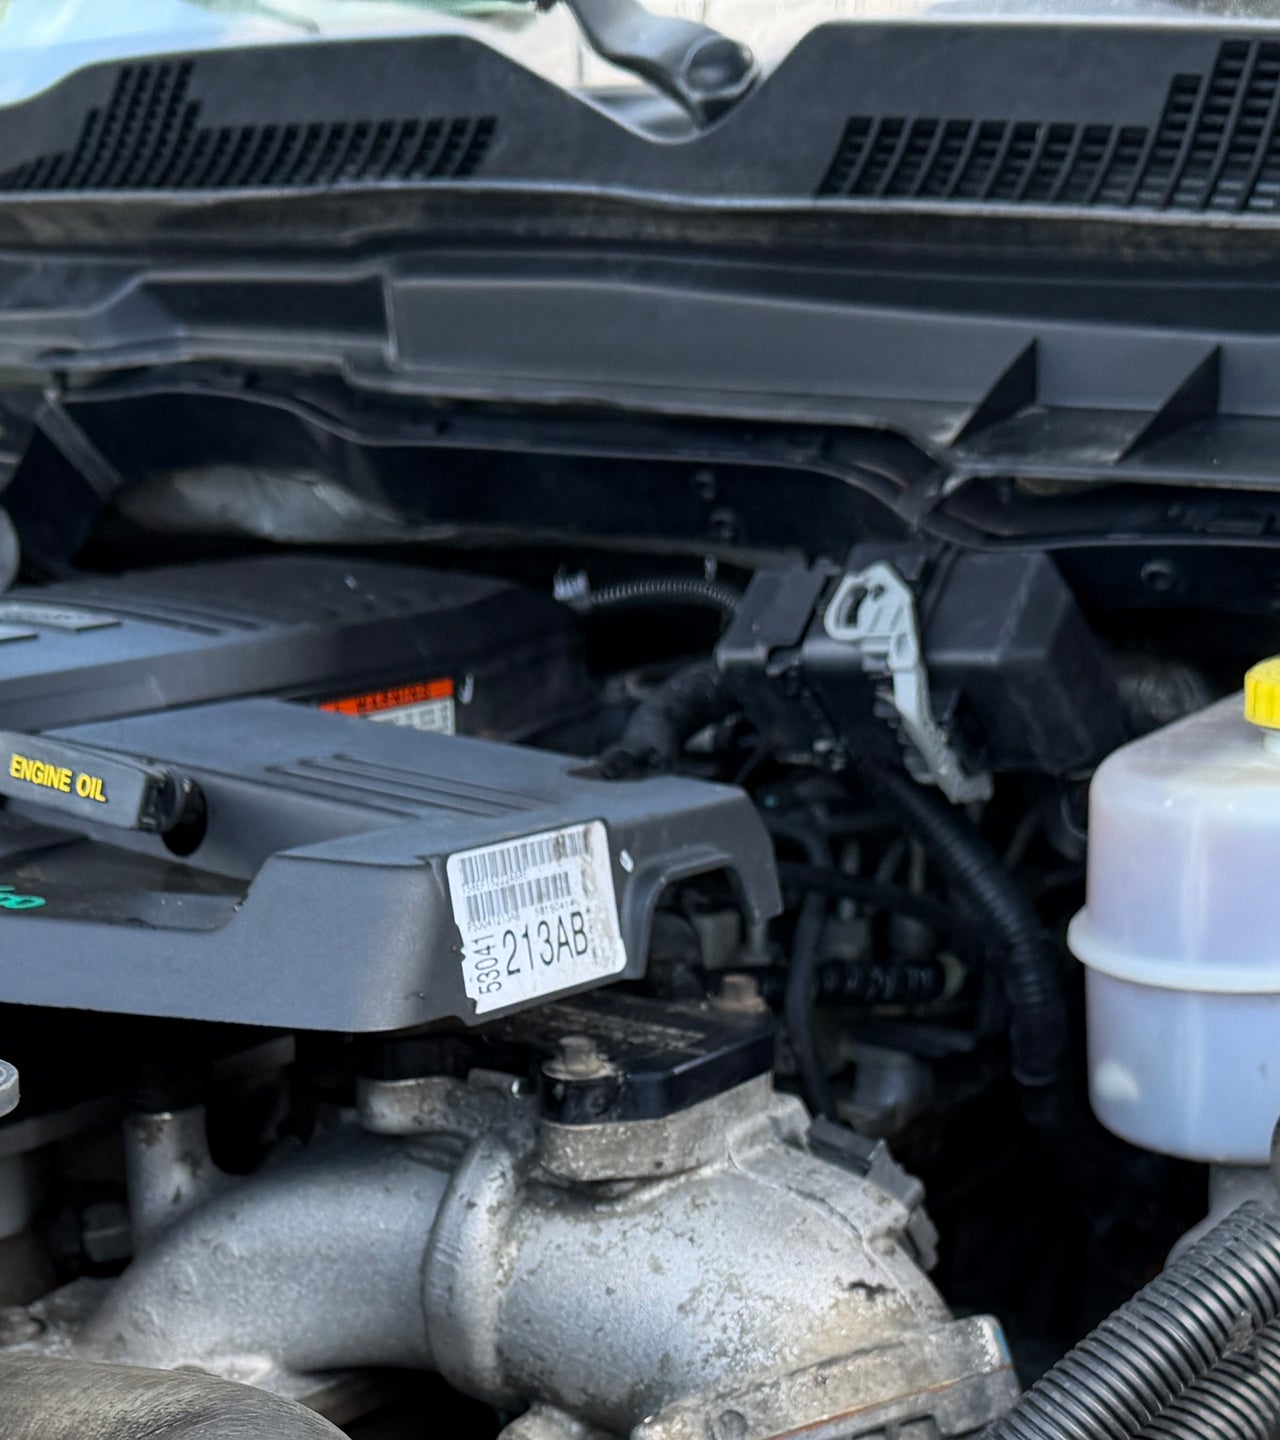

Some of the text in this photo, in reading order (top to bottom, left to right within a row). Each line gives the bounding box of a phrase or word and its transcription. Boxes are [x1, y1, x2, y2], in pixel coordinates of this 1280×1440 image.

[9, 752, 107, 803] ENGINE OIL
[472, 933, 503, 996] 53041
[502, 911, 589, 977] 213AB
